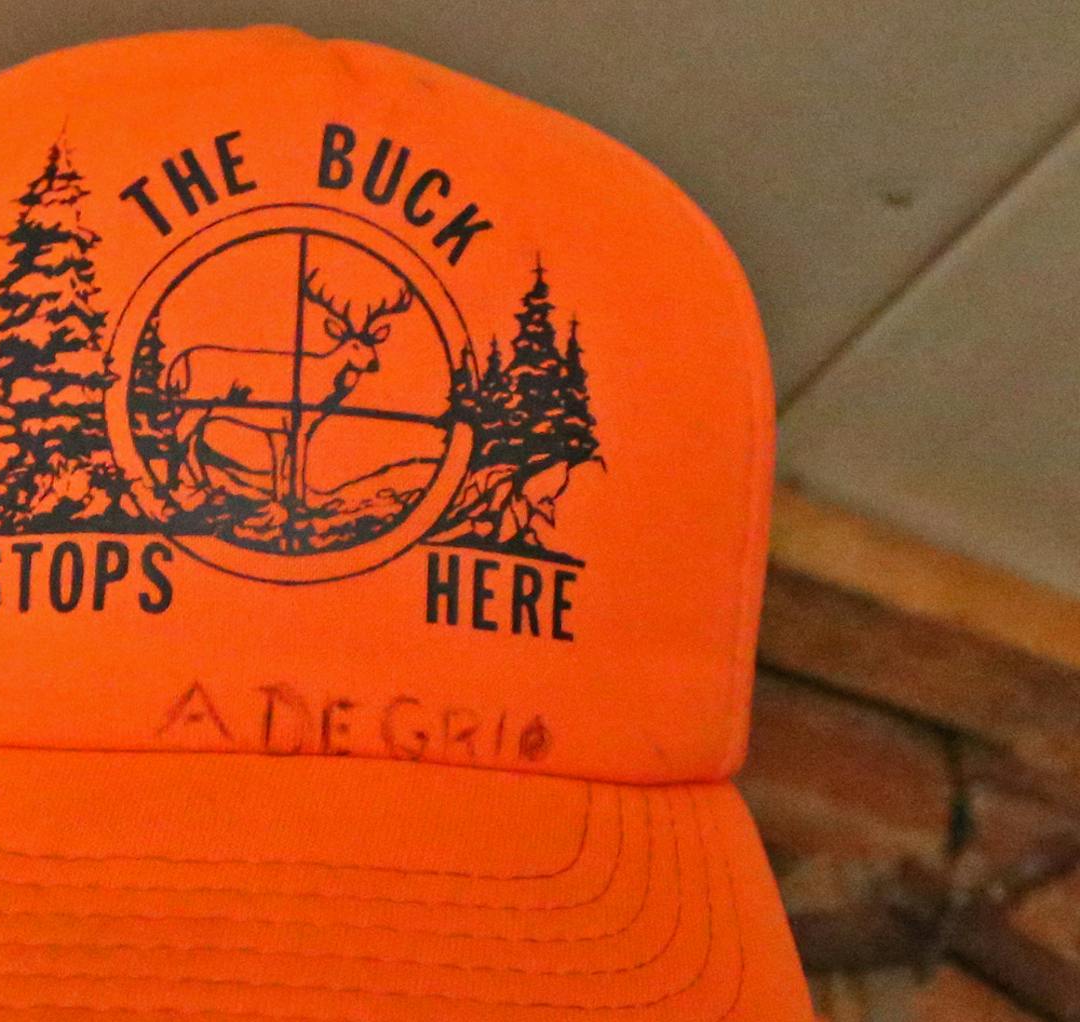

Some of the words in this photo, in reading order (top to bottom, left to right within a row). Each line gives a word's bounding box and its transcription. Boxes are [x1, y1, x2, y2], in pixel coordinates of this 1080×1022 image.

[120, 130, 258, 238] THE
[316, 122, 493, 267] BUCK
[426, 552, 578, 642] HERE
